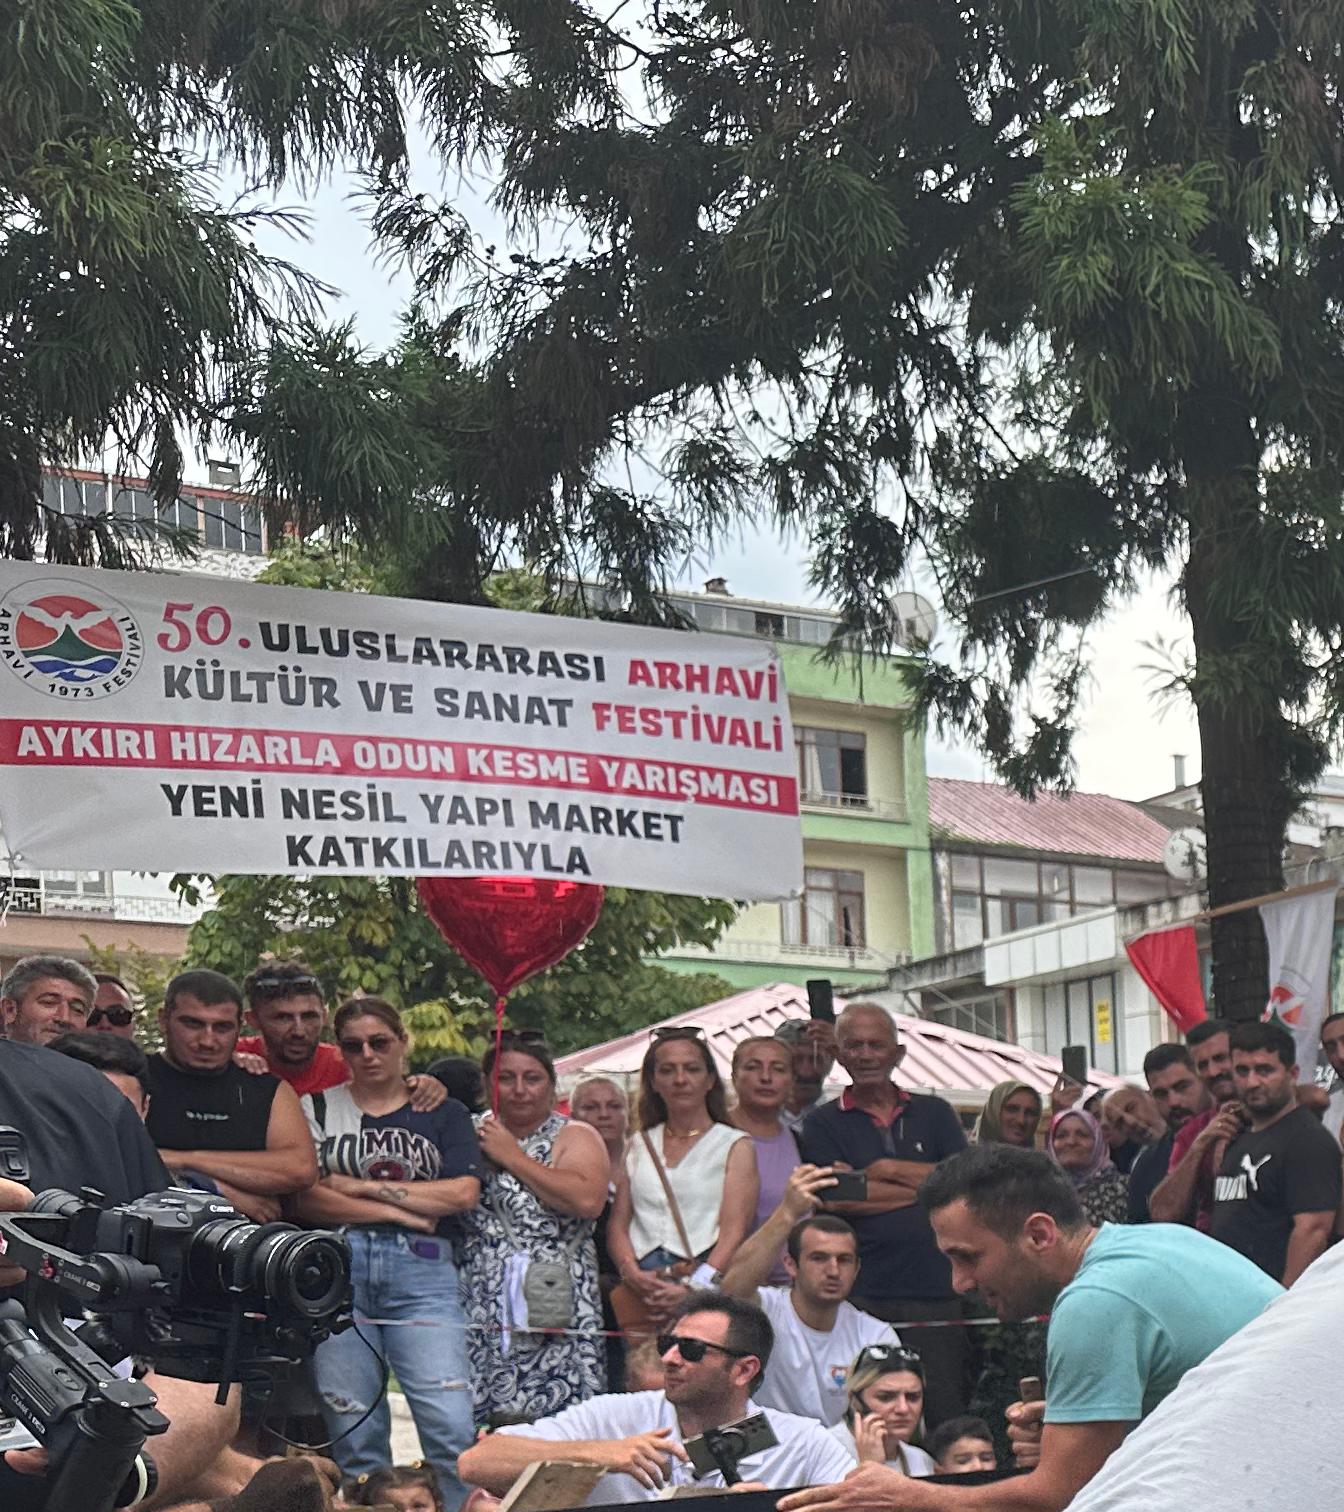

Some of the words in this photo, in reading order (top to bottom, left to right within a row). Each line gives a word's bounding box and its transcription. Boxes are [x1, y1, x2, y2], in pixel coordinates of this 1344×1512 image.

[157, 601, 252, 653] 50.
[258, 621, 606, 683] ULUSLARARASI
[628, 658, 778, 704] ARHAVİ
[48, 682, 95, 698] 1973
[163, 658, 342, 709] KÜLTÜR
[358, 679, 414, 714] VE
[434, 687, 573, 728] SANAT
[591, 701, 784, 753] FESTİVALİ
[16, 724, 156, 760] AYKIRI
[169, 730, 341, 768] HIZARLA
[353, 740, 455, 774] ODUN
[467, 747, 591, 785] KESME
[598, 759, 780, 807] YARIŞMASI
[160, 778, 264, 818] YENİ
[280, 783, 408, 823] NESİL
[419, 793, 513, 828] YAPI
[528, 801, 684, 843] MARKET
[285, 834, 592, 876] KATKILARIYLA
